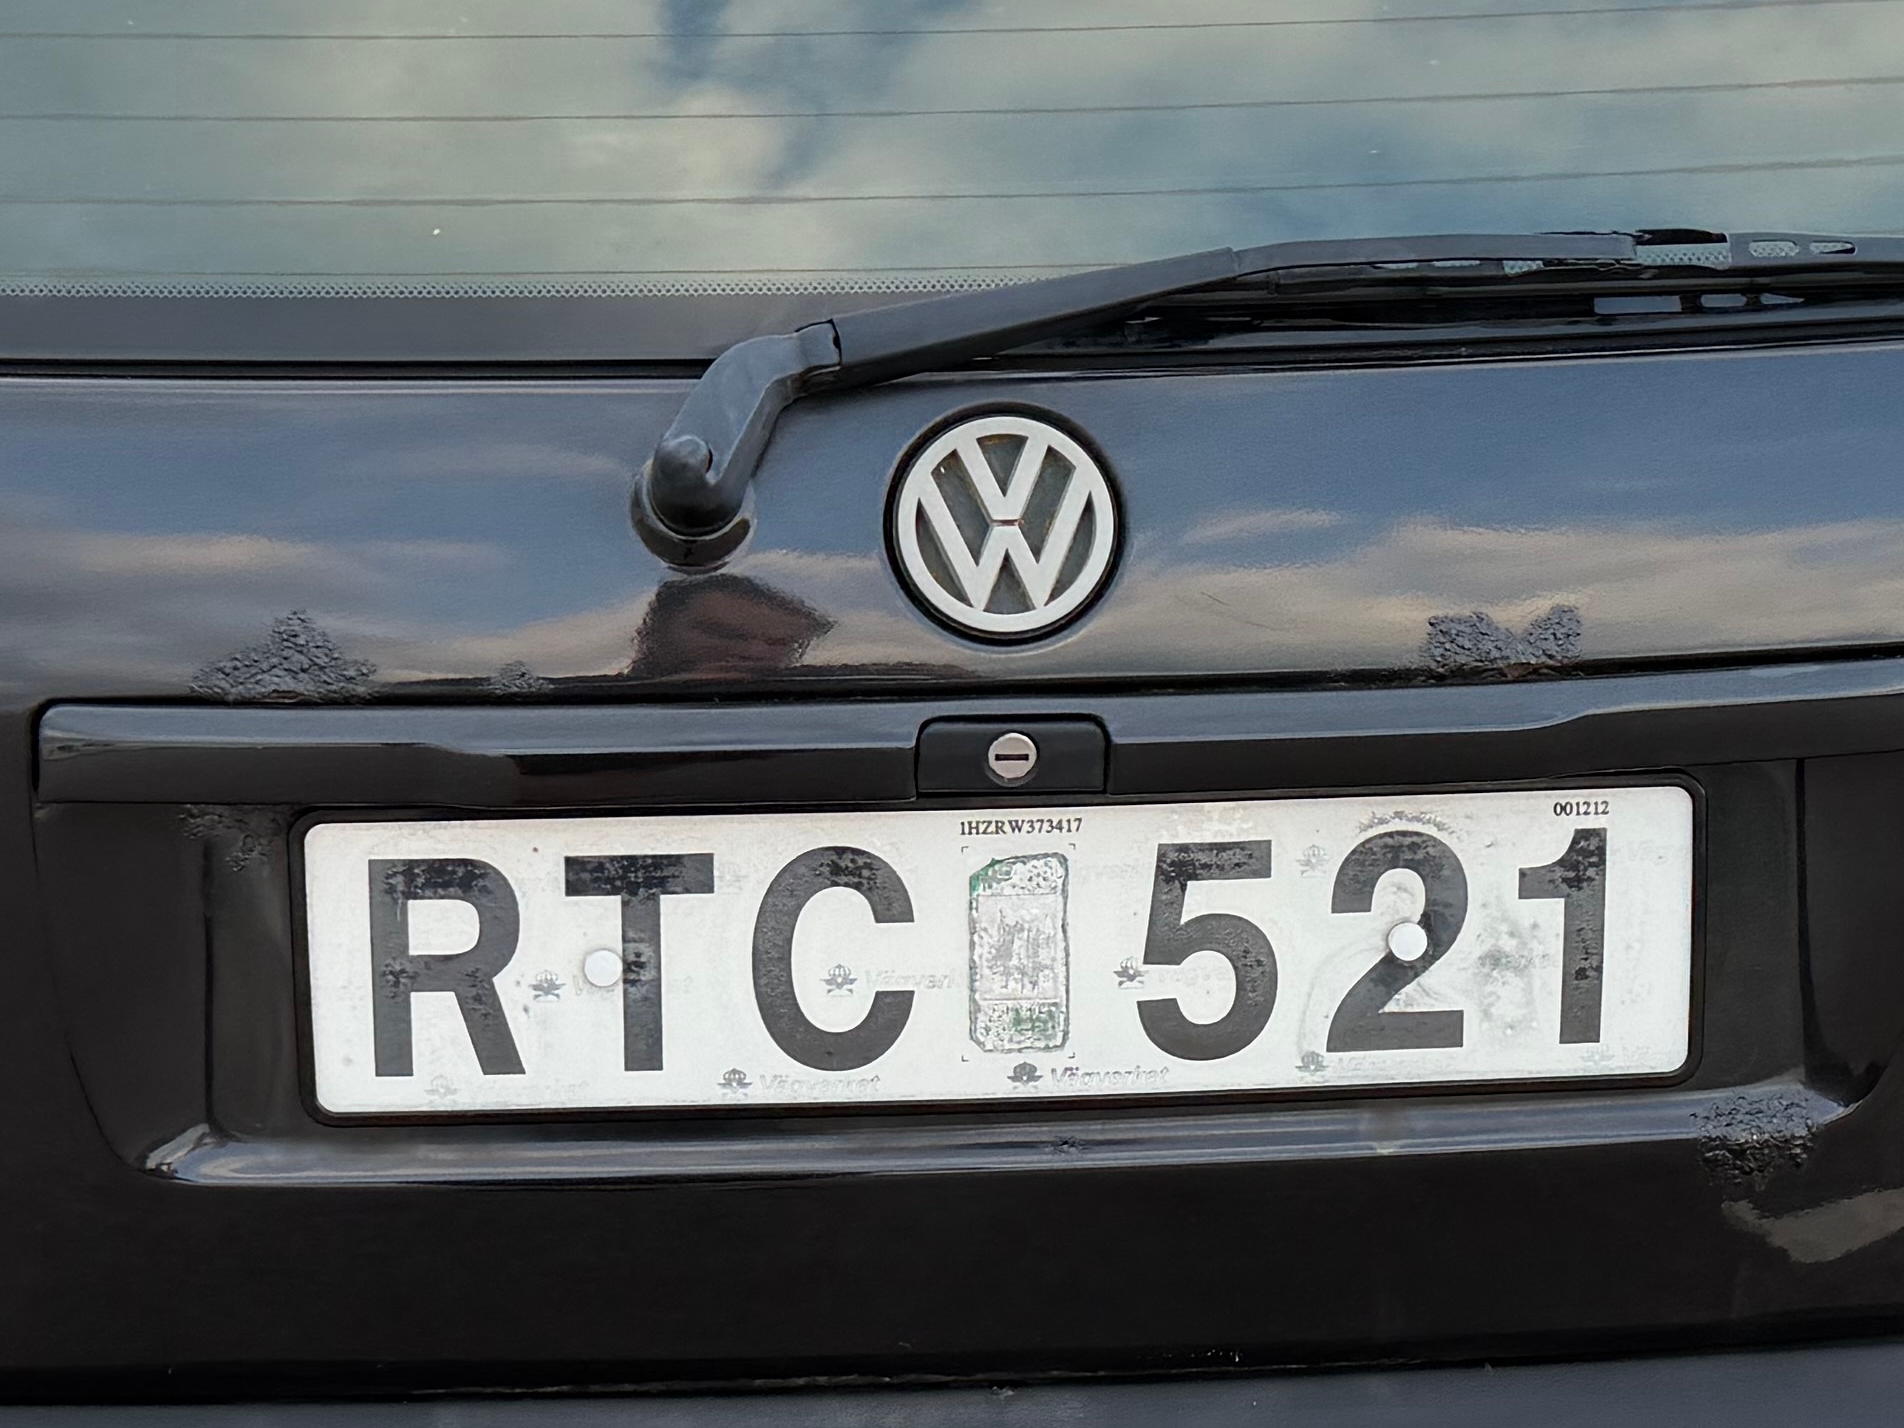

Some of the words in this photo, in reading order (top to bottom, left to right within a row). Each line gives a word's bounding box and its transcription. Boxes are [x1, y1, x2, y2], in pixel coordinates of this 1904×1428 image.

[898, 416, 1115, 632] VW
[959, 817, 1083, 836] 1HZRW373417
[1552, 800, 1610, 817] 001212
[368, 845, 915, 1078] RTC
[1137, 828, 1608, 1062] 521
